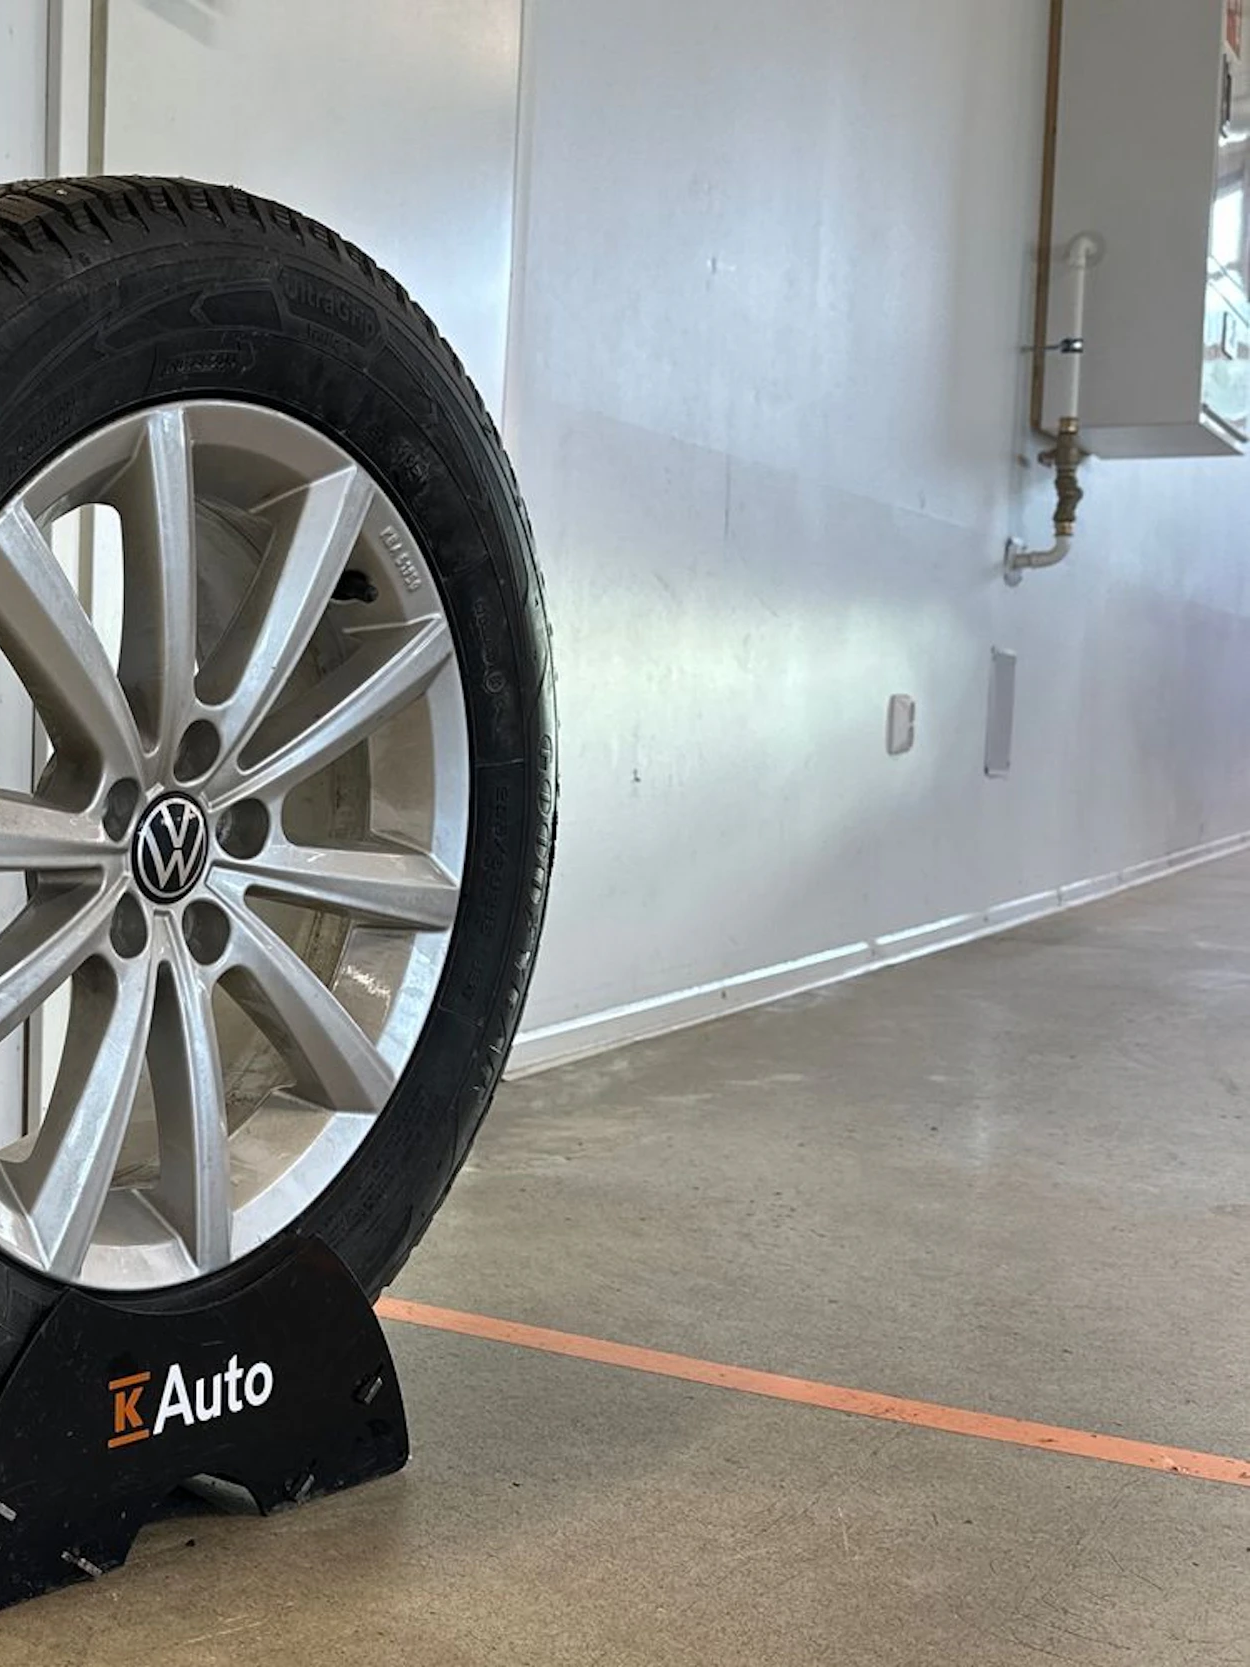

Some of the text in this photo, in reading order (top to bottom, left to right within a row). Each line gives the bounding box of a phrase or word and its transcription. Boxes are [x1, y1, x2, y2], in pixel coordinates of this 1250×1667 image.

[138, 798, 206, 898] VW
[113, 1354, 274, 1436] K Auto
